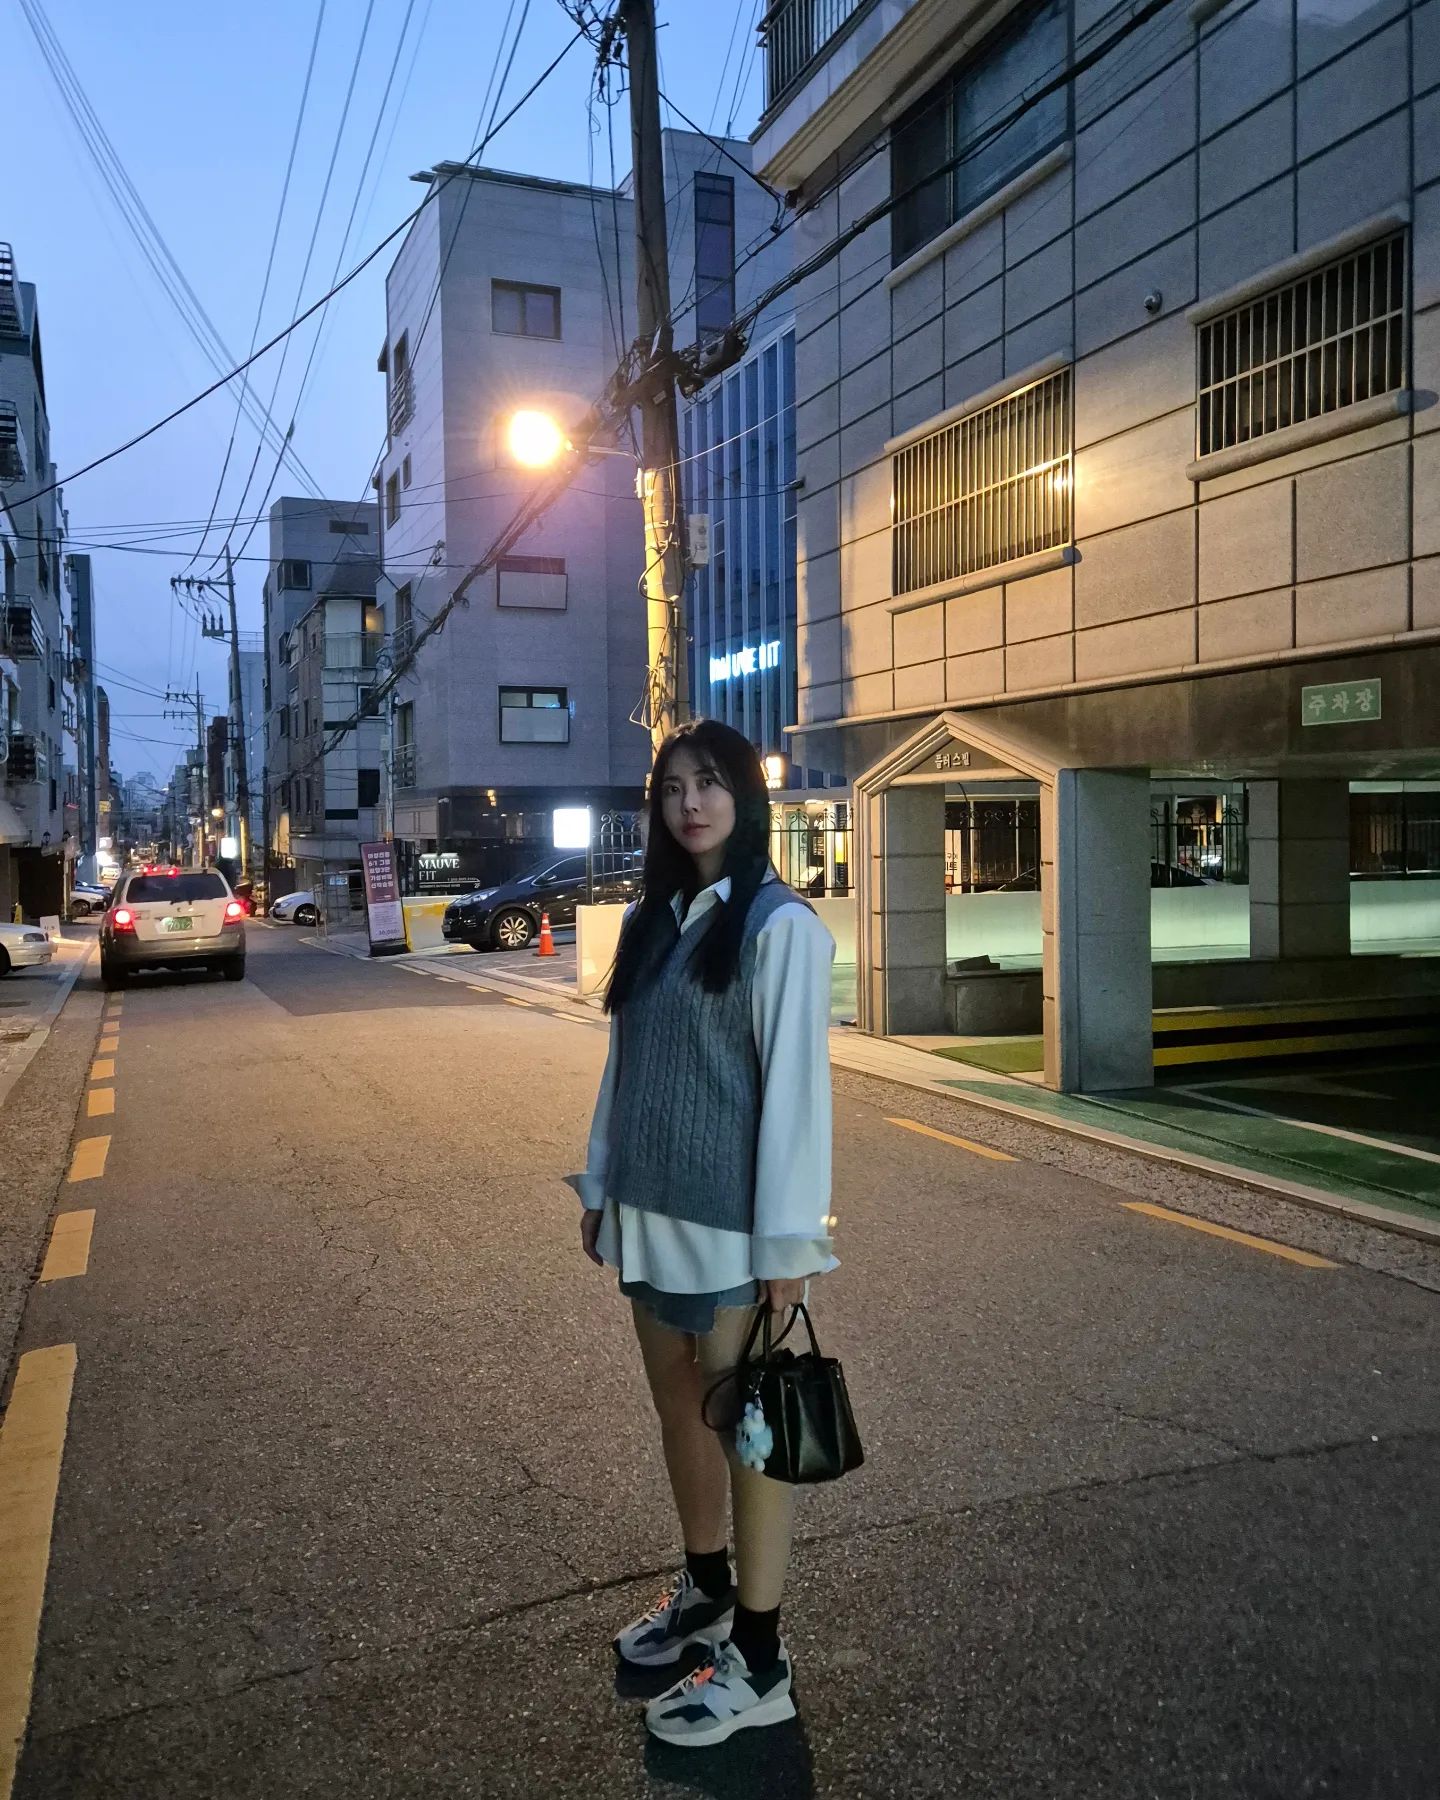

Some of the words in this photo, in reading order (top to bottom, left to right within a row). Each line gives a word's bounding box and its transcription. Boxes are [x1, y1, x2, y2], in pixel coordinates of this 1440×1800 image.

[1308, 688, 1373, 716] 주차장
[935, 752, 970, 769] 플러스빌
[418, 858, 460, 869] MAUVE
[418, 870, 437, 881] FIT
